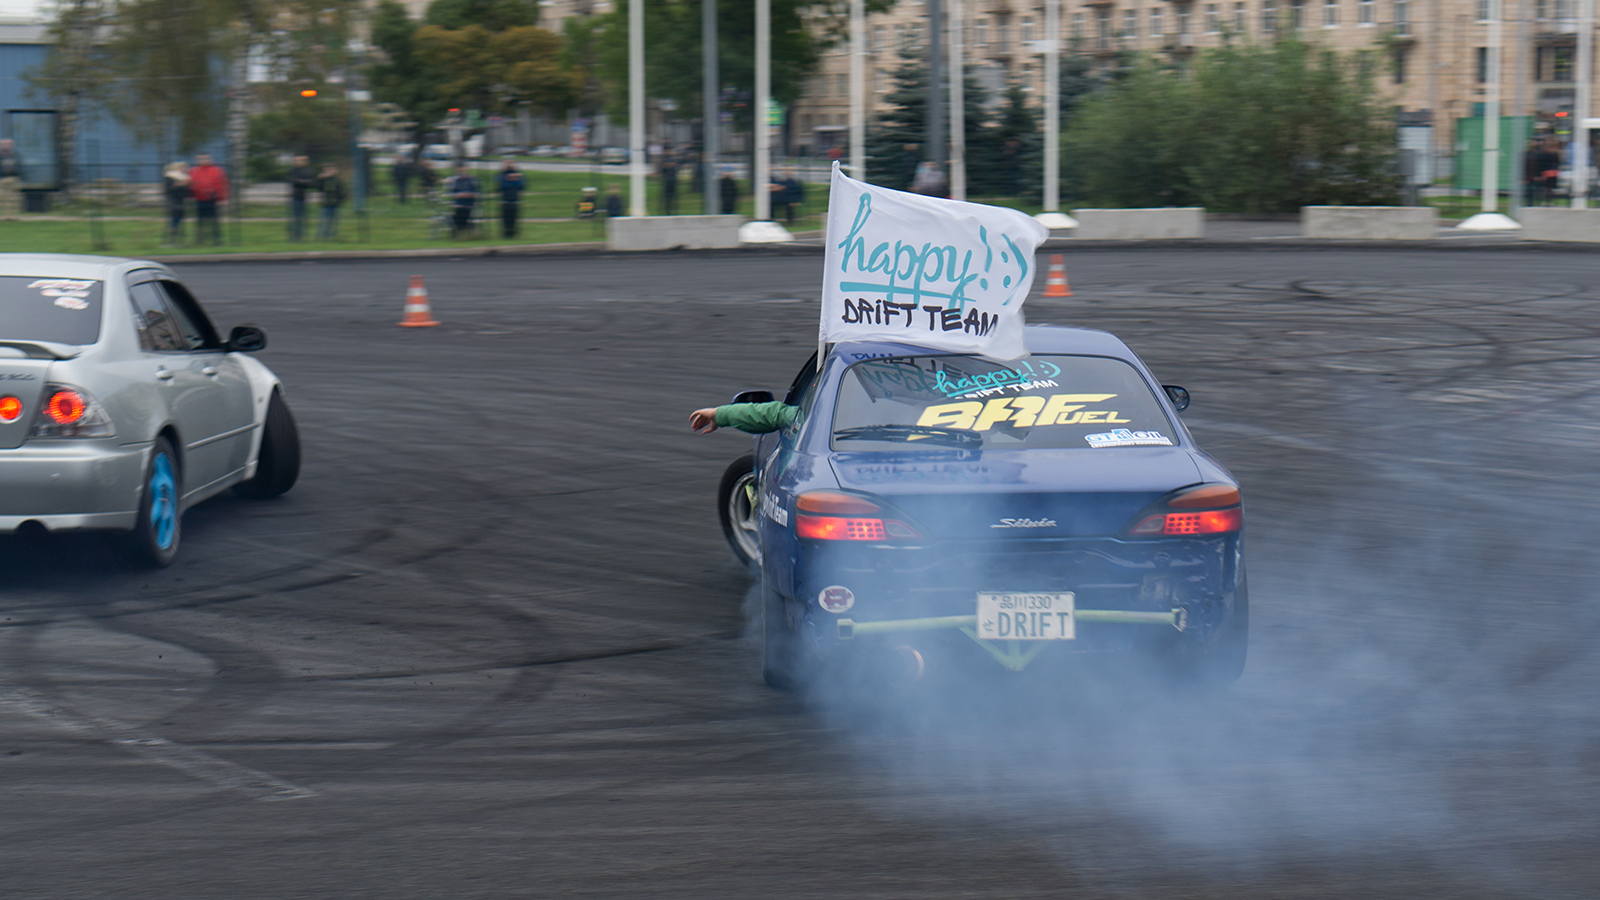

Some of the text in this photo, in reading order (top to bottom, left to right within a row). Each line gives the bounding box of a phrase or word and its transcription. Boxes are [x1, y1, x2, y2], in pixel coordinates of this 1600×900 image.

[923, 305, 999, 336] TEAM
[1005, 379, 1059, 393] TEAM
[998, 611, 1069, 637] DRIFT
